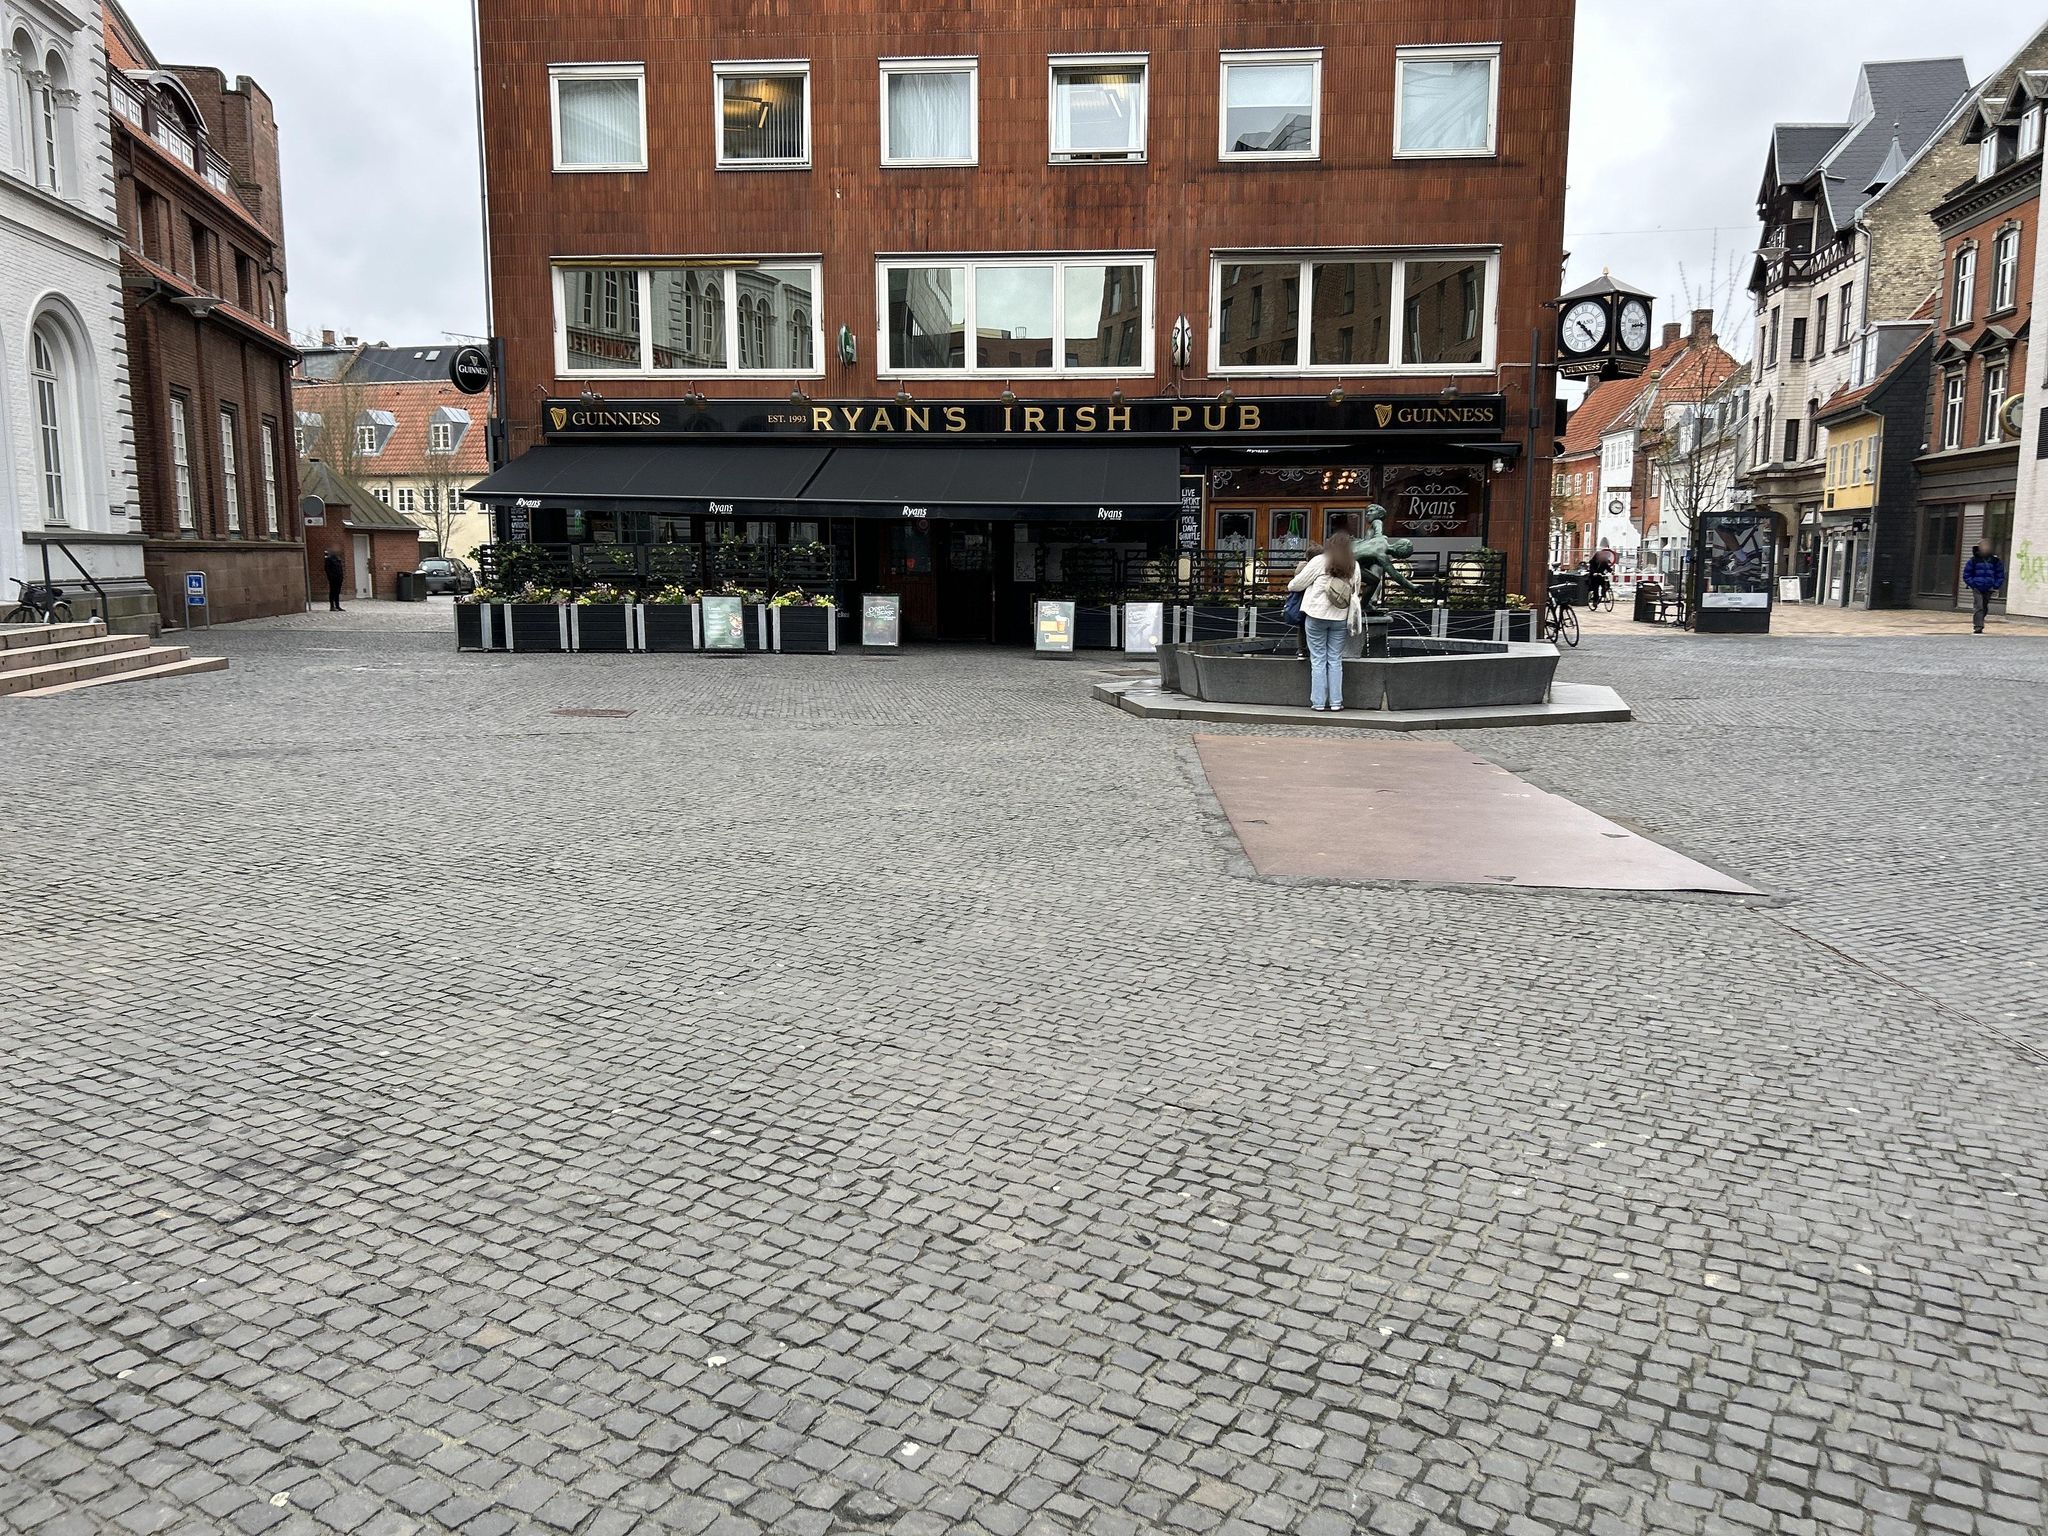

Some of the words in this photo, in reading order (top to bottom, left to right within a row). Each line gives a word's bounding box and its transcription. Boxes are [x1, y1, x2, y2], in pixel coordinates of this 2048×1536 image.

[458, 364, 489, 375] GUINNESS
[1566, 363, 1600, 373] GUINNESS
[572, 411, 661, 426] GUINNESS
[767, 414, 786, 423] EST.
[788, 415, 807, 424] 1993
[811, 406, 967, 432] RYAN'S
[1003, 405, 1132, 432] IRISH
[1171, 404, 1262, 431] PUB
[1397, 407, 1494, 423] GUINNESS
[1181, 488, 1196, 497] LIVE
[1181, 515, 1197, 525] POOL
[1182, 524, 1199, 533] DART
